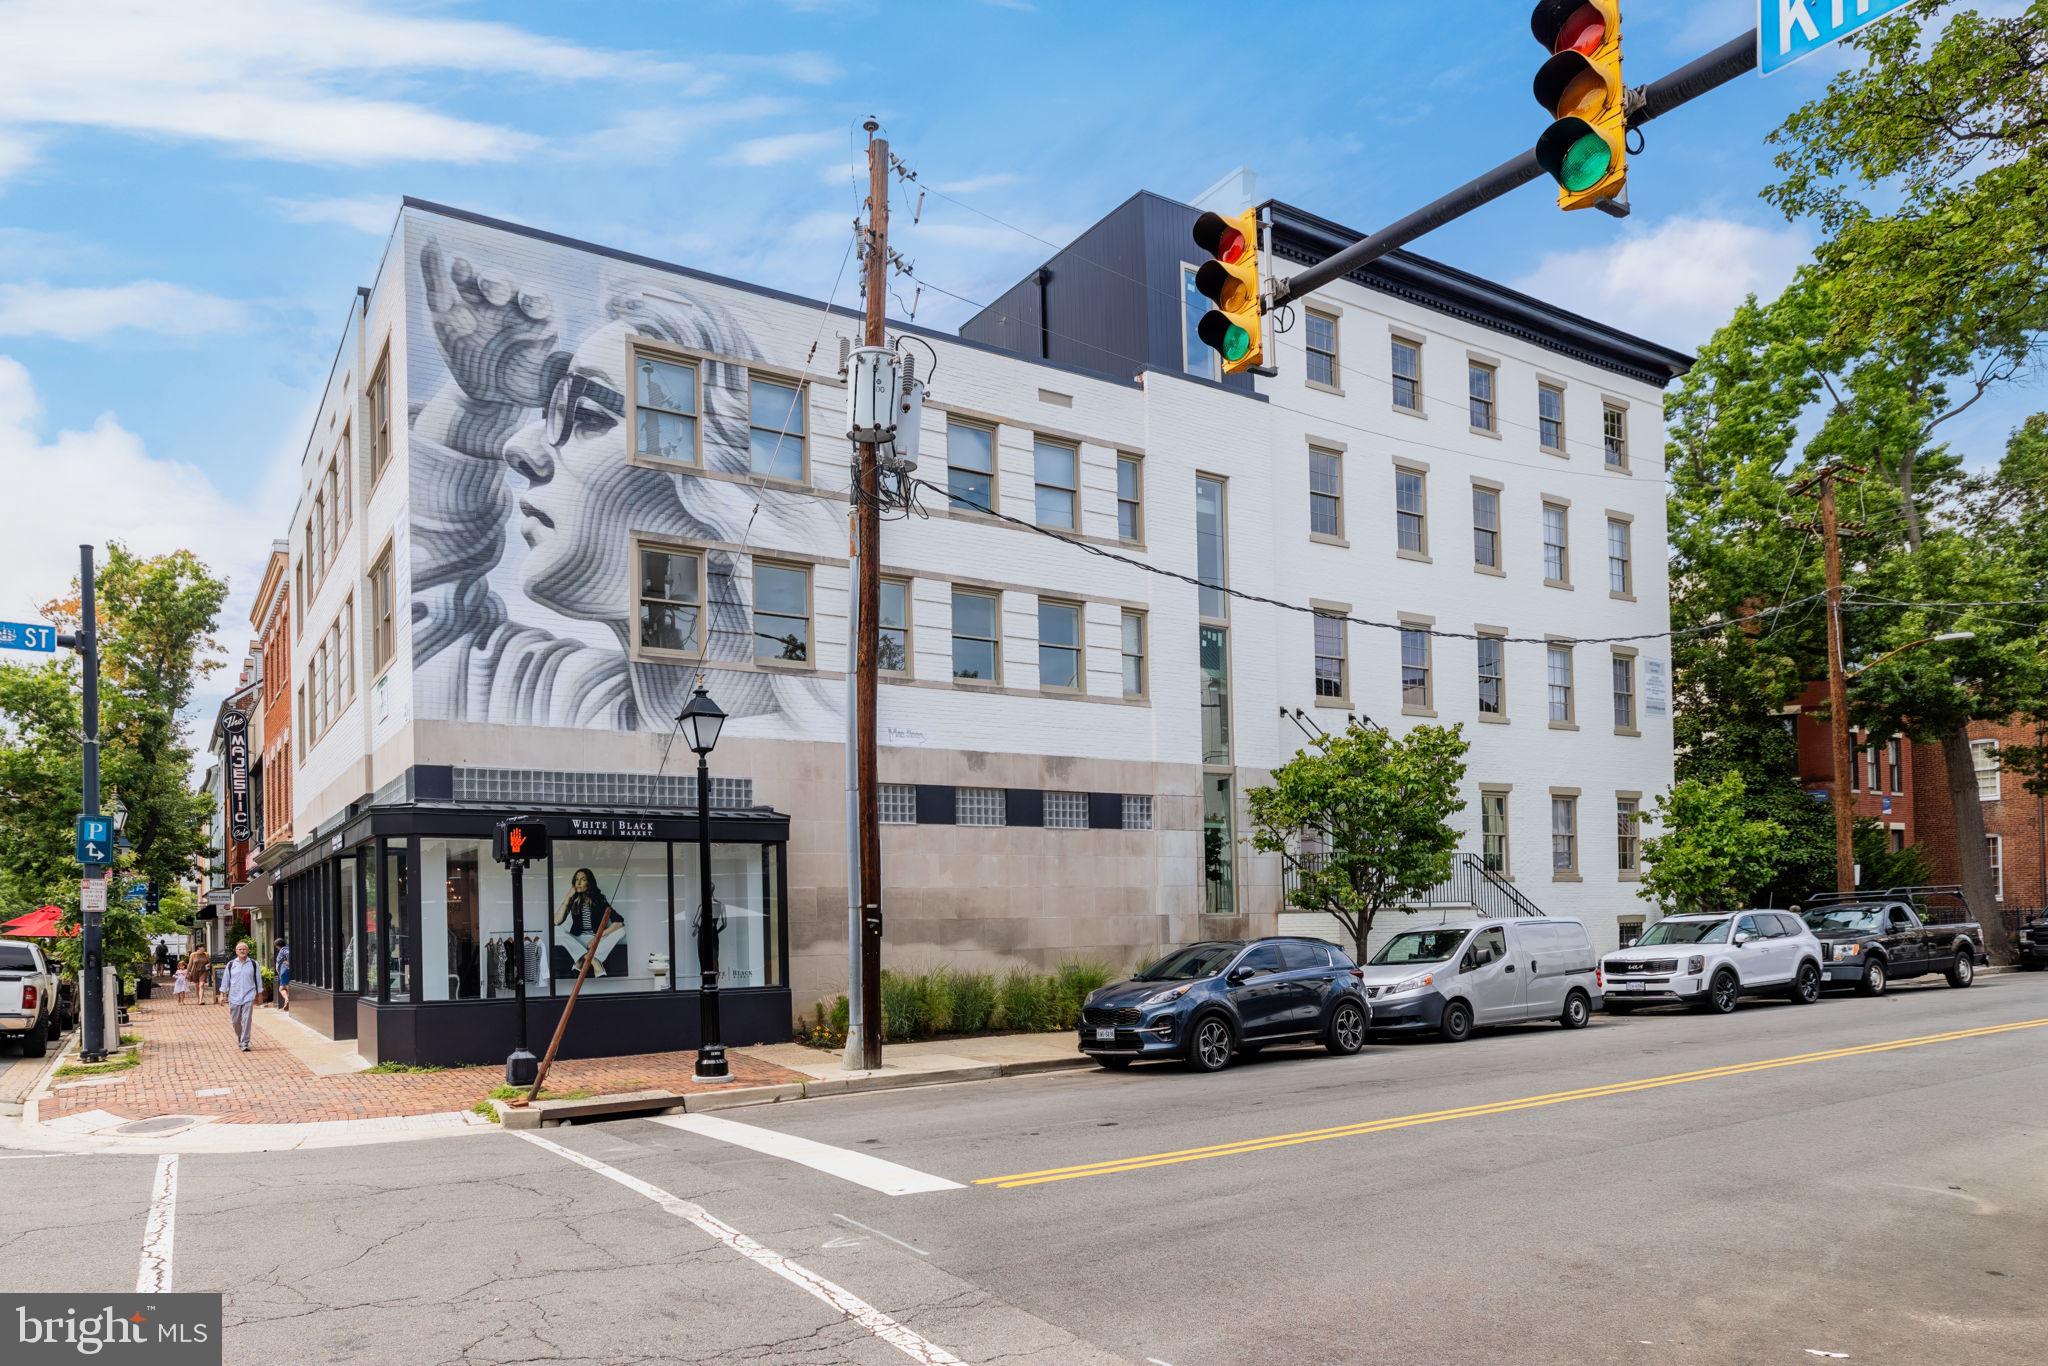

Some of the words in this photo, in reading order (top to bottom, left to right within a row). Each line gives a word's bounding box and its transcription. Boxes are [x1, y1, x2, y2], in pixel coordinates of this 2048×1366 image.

[24, 627, 50, 649] ST
[223, 714, 244, 728] The
[231, 734, 247, 823] MAJESTIC
[88, 823, 103, 840] P
[572, 819, 608, 829] WHITE
[618, 820, 654, 831] BLACK
